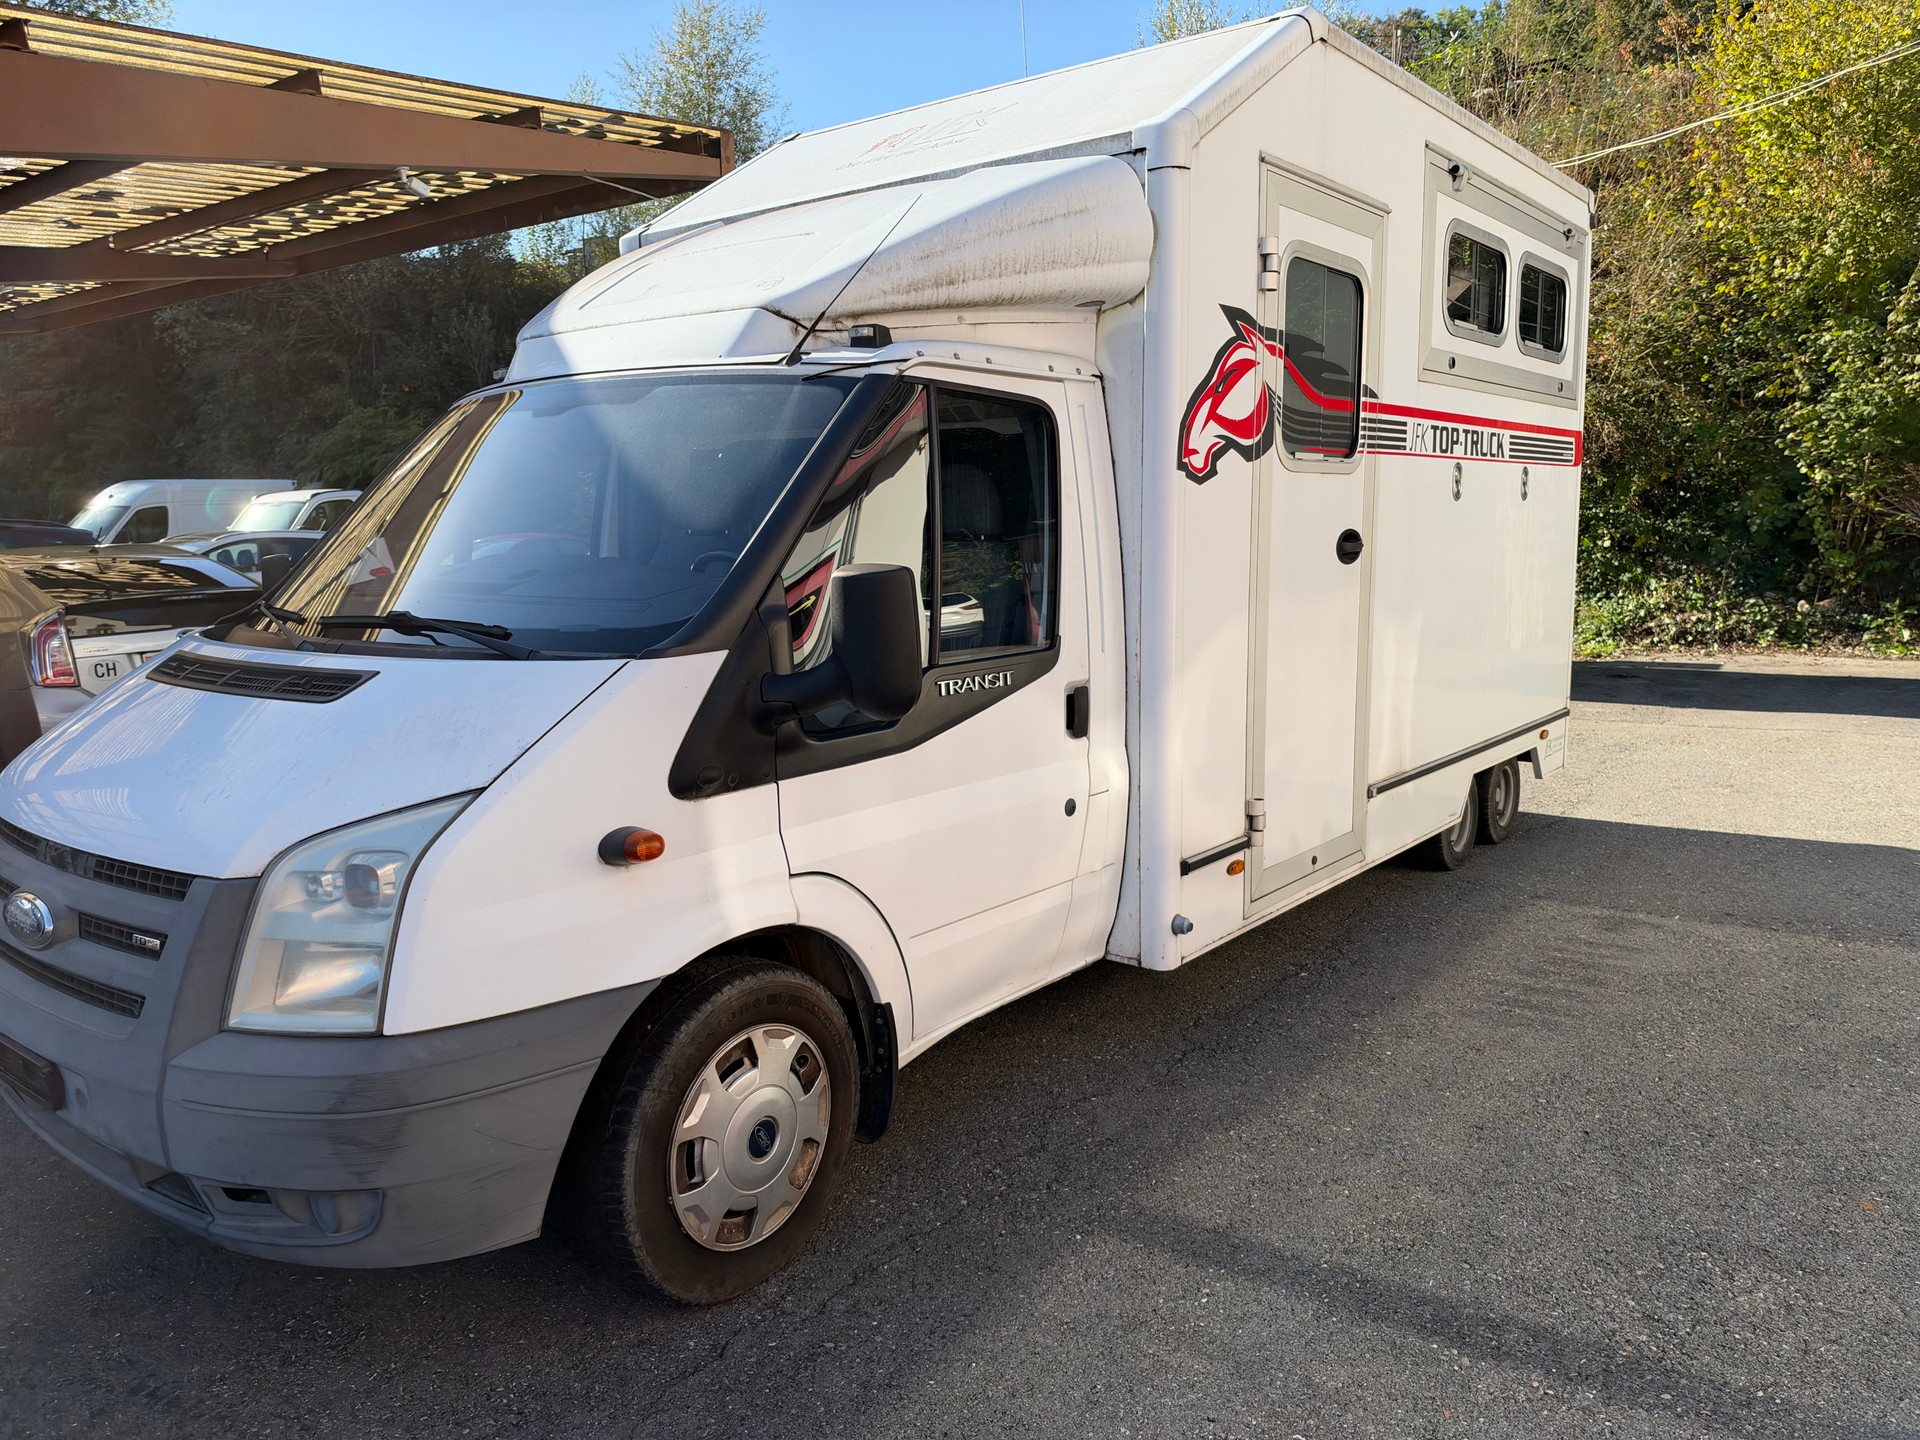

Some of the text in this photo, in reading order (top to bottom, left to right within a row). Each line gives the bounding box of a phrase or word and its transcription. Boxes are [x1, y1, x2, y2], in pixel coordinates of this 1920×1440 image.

[1409, 422, 1429, 453] JFK
[94, 663, 118, 678] CH
[936, 671, 1014, 697] TRANSIT
